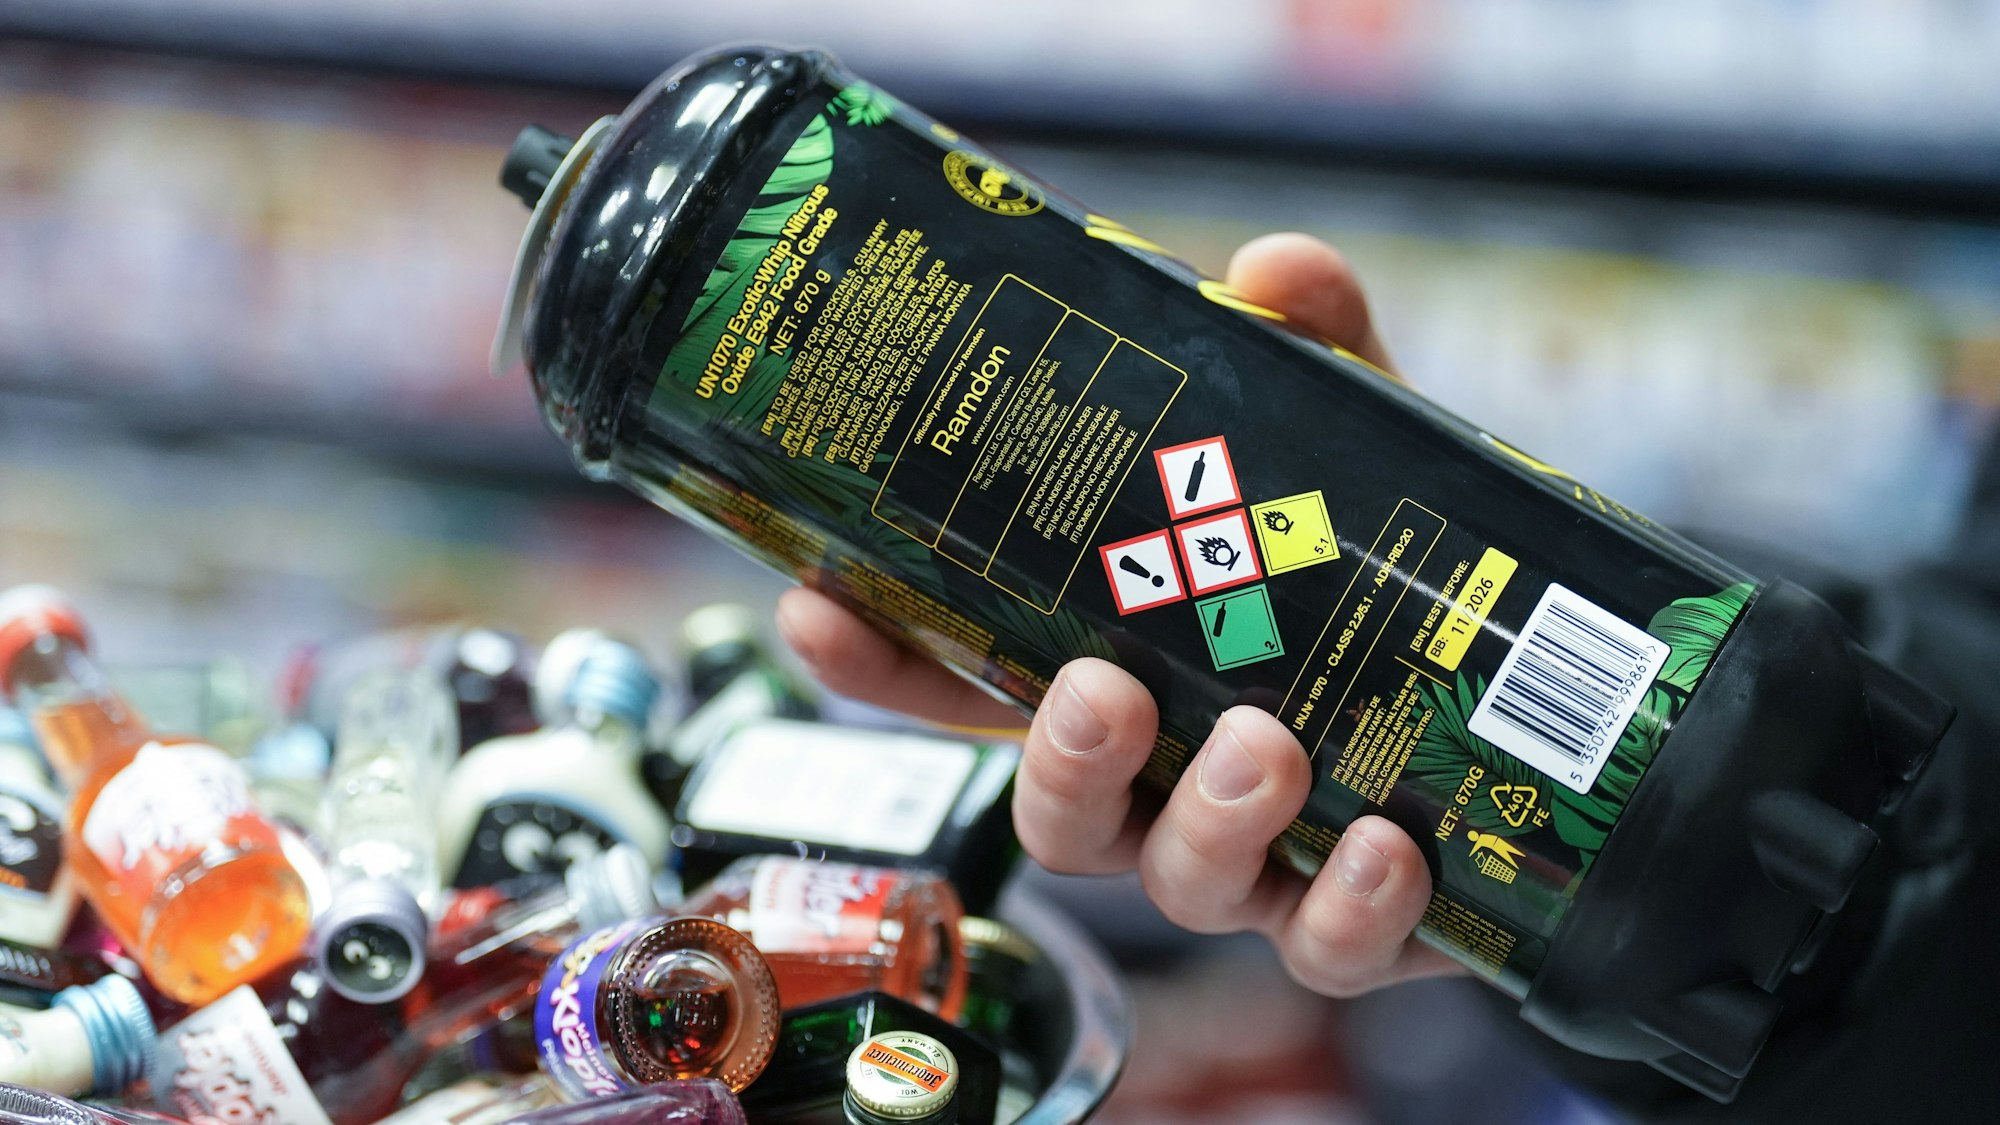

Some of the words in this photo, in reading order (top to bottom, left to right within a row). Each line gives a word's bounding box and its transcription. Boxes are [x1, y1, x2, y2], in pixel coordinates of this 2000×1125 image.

[695, 333, 737, 398] UN1070
[727, 239, 794, 338] ExoticWhip
[781, 184, 829, 240] Nitrous
[721, 345, 755, 394] Oxide
[745, 299, 780, 345] E942
[769, 253, 807, 301] Food
[797, 207, 838, 255] Grade
[761, 412, 779, 435] [EN]
[770, 396, 784, 411] TO
[779, 380, 793, 397] BE
[787, 350, 808, 380] USED
[803, 326, 822, 350] FOR
[817, 268, 859, 325] COCKTAILS,
[853, 218, 888, 265] CULINARY
[769, 315, 801, 355] NET:
[793, 282, 819, 313] 670
[815, 269, 831, 283] g
[775, 386, 804, 425] DISHES,
[798, 347, 822, 383] CAKES
[818, 323, 835, 347] AND
[830, 275, 864, 322] WHIPPED
[860, 239, 889, 275] CREAM.
[793, 376, 821, 420] UTILISER
[815, 347, 836, 377] POUR
[831, 327, 848, 348] LES
[842, 275, 882, 328] COCKTAILS,
[875, 255, 894, 274] LES
[887, 228, 912, 256] PLATS
[821, 361, 858, 415] COCKTAILS,
[851, 289, 898, 359] KULINARISCHE
[892, 245, 929, 290] GERICHTE,
[814, 381, 830, 401] LES
[850, 319, 863, 335] ET
[858, 308, 872, 321] LA
[824, 442, 841, 463] [ES]
[833, 417, 852, 443] PARA
[846, 395, 863, 417] SER
[857, 360, 882, 395] USADO
[877, 344, 892, 361] EN
[886, 294, 924, 345] CÓCTELES,
[917, 259, 945, 293] PLATOS
[825, 390, 851, 429] TORTEN
[845, 368, 863, 391] UND
[858, 345, 876, 369] ZUM
[871, 276, 919, 346] SCHLAGSAHNE
[837, 400, 875, 458] CULINARIOS,
[868, 348, 904, 398] PASTELES,
[903, 304, 929, 338] CREMA
[923, 273, 949, 305] BATIDA
[856, 433, 870, 448] DA
[864, 376, 900, 432] UTILIZZARE
[894, 356, 912, 378] PER
[906, 310, 942, 356] COCKTAIL,
[935, 279, 959, 308] PIATTI
[858, 399, 904, 473] GASTRONOMICI,
[896, 363, 922, 396] TORTE
[921, 324, 946, 356] PANNA
[940, 283, 973, 324] MONTATA
[913, 409, 938, 444] Officially
[933, 370, 959, 411] produced
[954, 359, 966, 372] by
[960, 327, 985, 361] Ramdon
[930, 345, 1011, 455] Ramdon
[971, 375, 1015, 445] www.ramdon.com
[971, 454, 992, 483] Ramdon
[987, 441, 1000, 455] Ltd.
[995, 420, 1011, 441] Quad
[1006, 396, 1025, 421] Central
[1020, 386, 1033, 398] Q3,
[1027, 366, 1043, 386] Level
[1039, 358, 1050, 367] 15,
[979, 477, 993, 491] Triq
[1010, 410, 1029, 435] Central
[1024, 382, 1047, 412] Business
[1041, 360, 1061, 383] District,
[1001, 441, 1025, 472] Birkirkara,
[1020, 406, 1046, 440] CBD1040,
[1039, 387, 1056, 406] Malta
[1016, 453, 1029, 466] Tel:
[1026, 434, 1039, 453] +356
[1024, 457, 1039, 475] Web:
[1036, 405, 1070, 457] exotic-whip.com
[1025, 500, 1040, 517] [EN]
[1033, 439, 1072, 502] NON-REFILLABLE
[1067, 405, 1093, 442] CYLINDER
[1032, 514, 1047, 531] [FR]
[1040, 478, 1065, 516] CYLINDER
[1060, 461, 1075, 480] NON
[1069, 404, 1109, 463] RECHARGEABLE
[1042, 522, 1057, 540] [DE]
[1050, 500, 1067, 525] NICHT
[1095, 409, 1121, 445] ZYLINDER
[1058, 519, 1073, 536] [ES]
[1067, 485, 1090, 520] CILINDRO
[1085, 473, 1097, 487] NO
[1092, 424, 1126, 474] RECARGABLE
[1075, 495, 1100, 532] BOMBOLA
[1094, 477, 1110, 497] NON
[1104, 429, 1138, 479] RICARICABILE
[1313, 537, 1329, 555] 5.1
[1264, 640, 1275, 651] 2
[1409, 628, 1430, 652] [EN]
[1422, 599, 1447, 629] BEST
[1437, 560, 1469, 604] BEFORE:
[1429, 636, 1448, 658] BB:
[1451, 577, 1493, 635] 11/2026
[1292, 700, 1314, 730] UN.Nr
[1308, 676, 1328, 700] 1070
[1327, 628, 1355, 666] CLASS
[1348, 596, 1373, 630] 2.2/5.1
[1569, 771, 1583, 783] 5
[1580, 709, 1620, 764] 350742
[1614, 655, 1651, 703] 999861
[1331, 764, 1345, 781] [FR]
[1342, 708, 1374, 758] CONSOMMER
[1369, 695, 1381, 709] DE
[1349, 774, 1363, 791] [DE]
[1357, 726, 1387, 776] MINDESTENS
[1383, 688, 1409, 727] HALTBAR
[1404, 671, 1419, 689] BIS:
[1358, 780, 1372, 797] [ES]
[1392, 705, 1411, 733] ANTES
[1406, 690, 1420, 706] DE:
[1366, 707, 1386, 738] AVANT:
[1373, 777, 1384, 789] DA
[1379, 725, 1412, 777] CONSUMARSI
[1376, 738, 1417, 806] PREFERIBILMENTE
[1412, 708, 1434, 739] ENTRO:
[1434, 806, 1462, 841] NET:
[1454, 765, 1485, 805] 670G
[1507, 792, 1524, 813] 40
[1532, 807, 1550, 827] FE
[550, 980, 620, 1097] Klopf
[575, 1021, 616, 1082] kleiner
